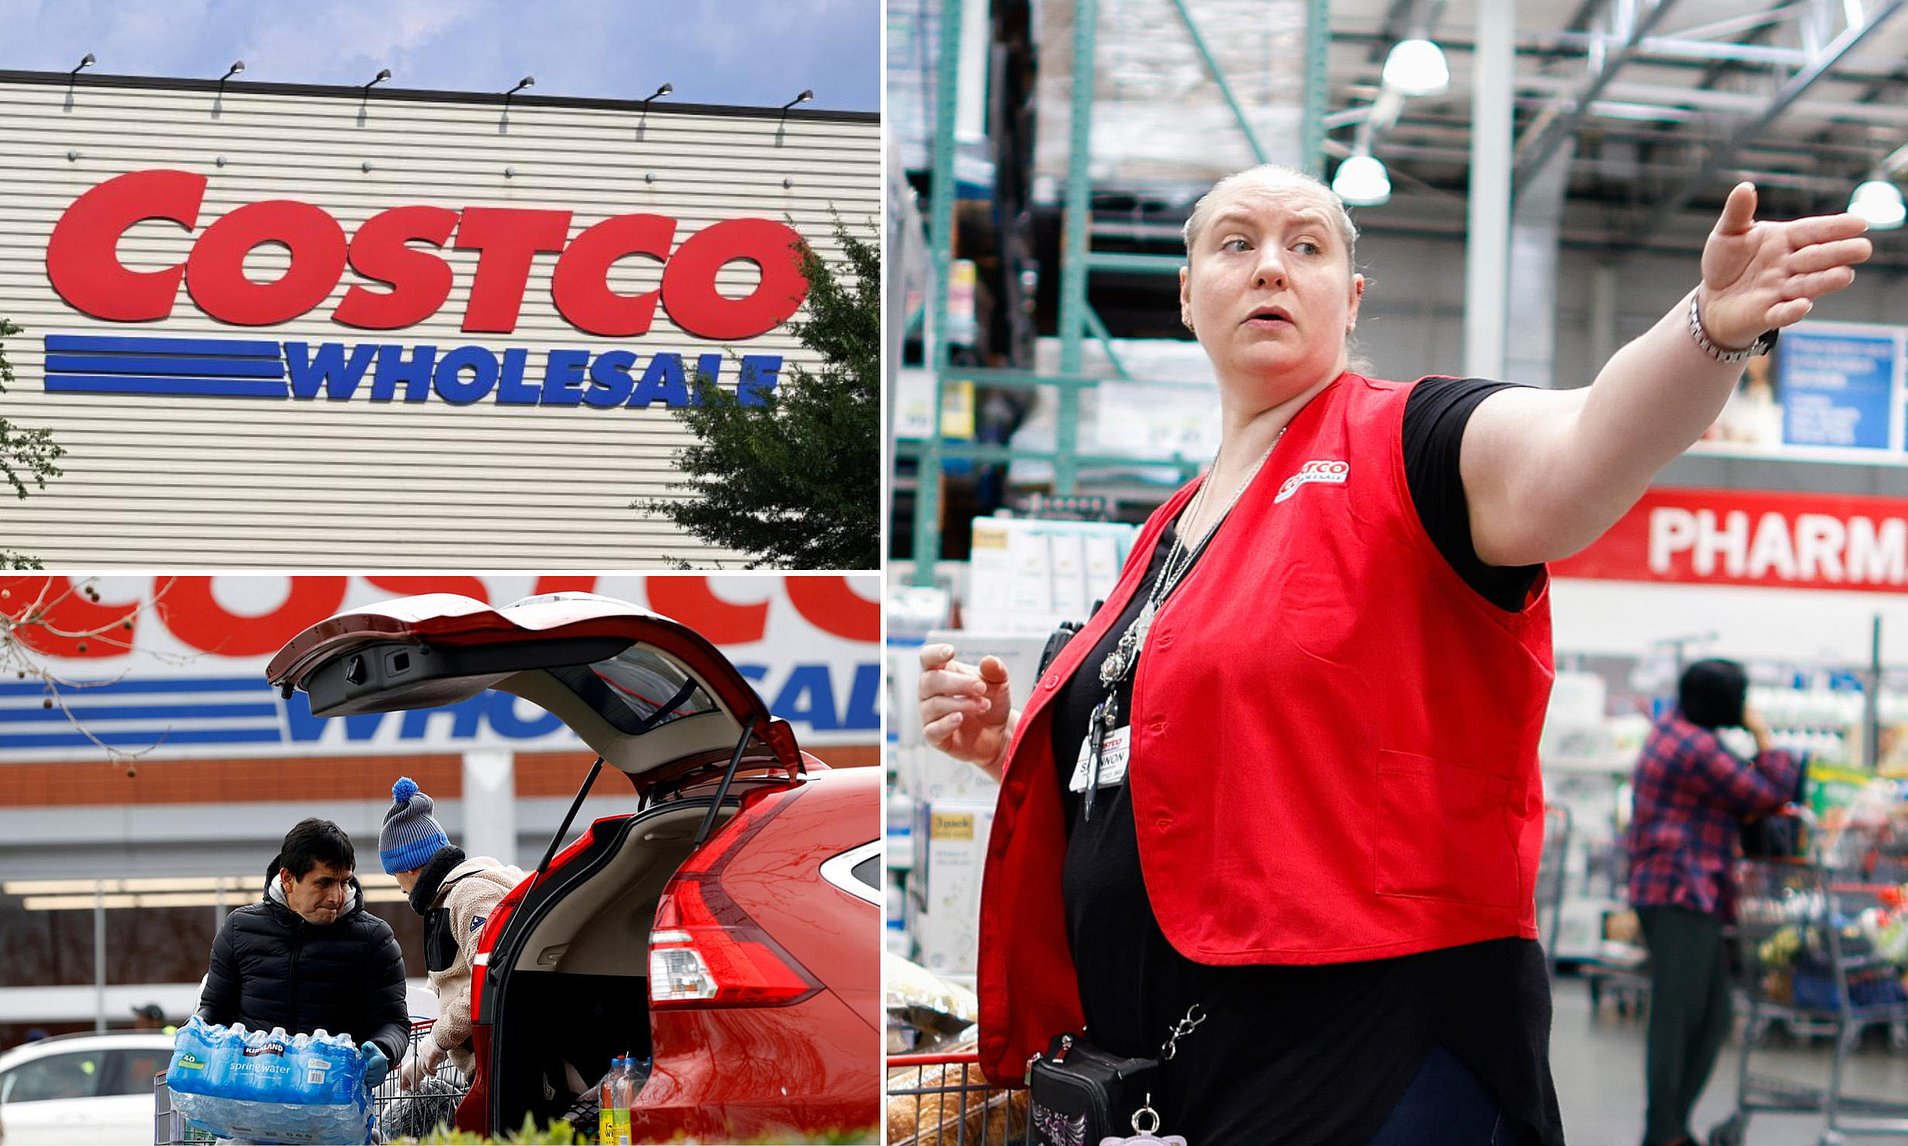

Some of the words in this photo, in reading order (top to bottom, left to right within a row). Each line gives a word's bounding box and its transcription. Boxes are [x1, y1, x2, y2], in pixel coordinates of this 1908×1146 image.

[46, 169, 811, 341] COSTCO
[284, 341, 783, 409] WHOLESALE
[1080, 752, 1124, 775] SNNON
